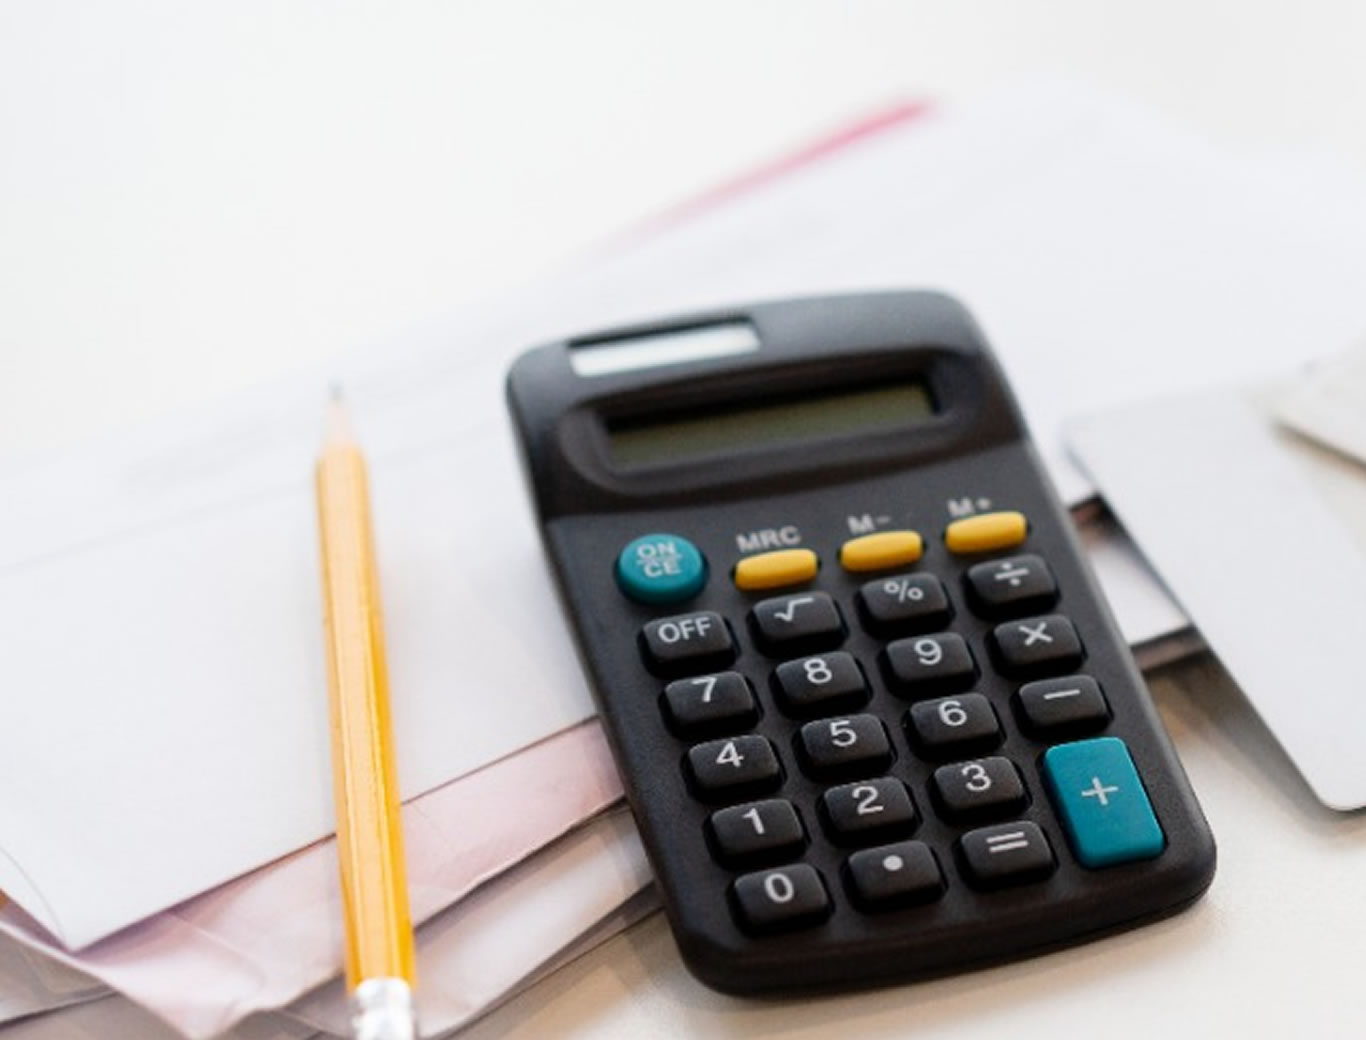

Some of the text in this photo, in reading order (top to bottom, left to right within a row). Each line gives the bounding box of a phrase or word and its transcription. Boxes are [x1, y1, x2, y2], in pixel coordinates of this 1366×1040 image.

[948, 497, 992, 518] M+
[637, 542, 677, 560] ON
[736, 526, 801, 552] MRC
[643, 560, 679, 578] CE
[884, 579, 923, 603] %
[657, 618, 711, 644] OFF
[914, 640, 942, 666] 9
[805, 658, 833, 685] 8
[691, 677, 718, 704] 7
[938, 700, 968, 728] 6
[830, 720, 857, 748] 5
[716, 742, 744, 769] 4
[962, 764, 992, 793] 3
[1081, 777, 1119, 806] +
[851, 787, 884, 816] 2
[741, 808, 766, 835] 1
[986, 830, 1027, 853] =
